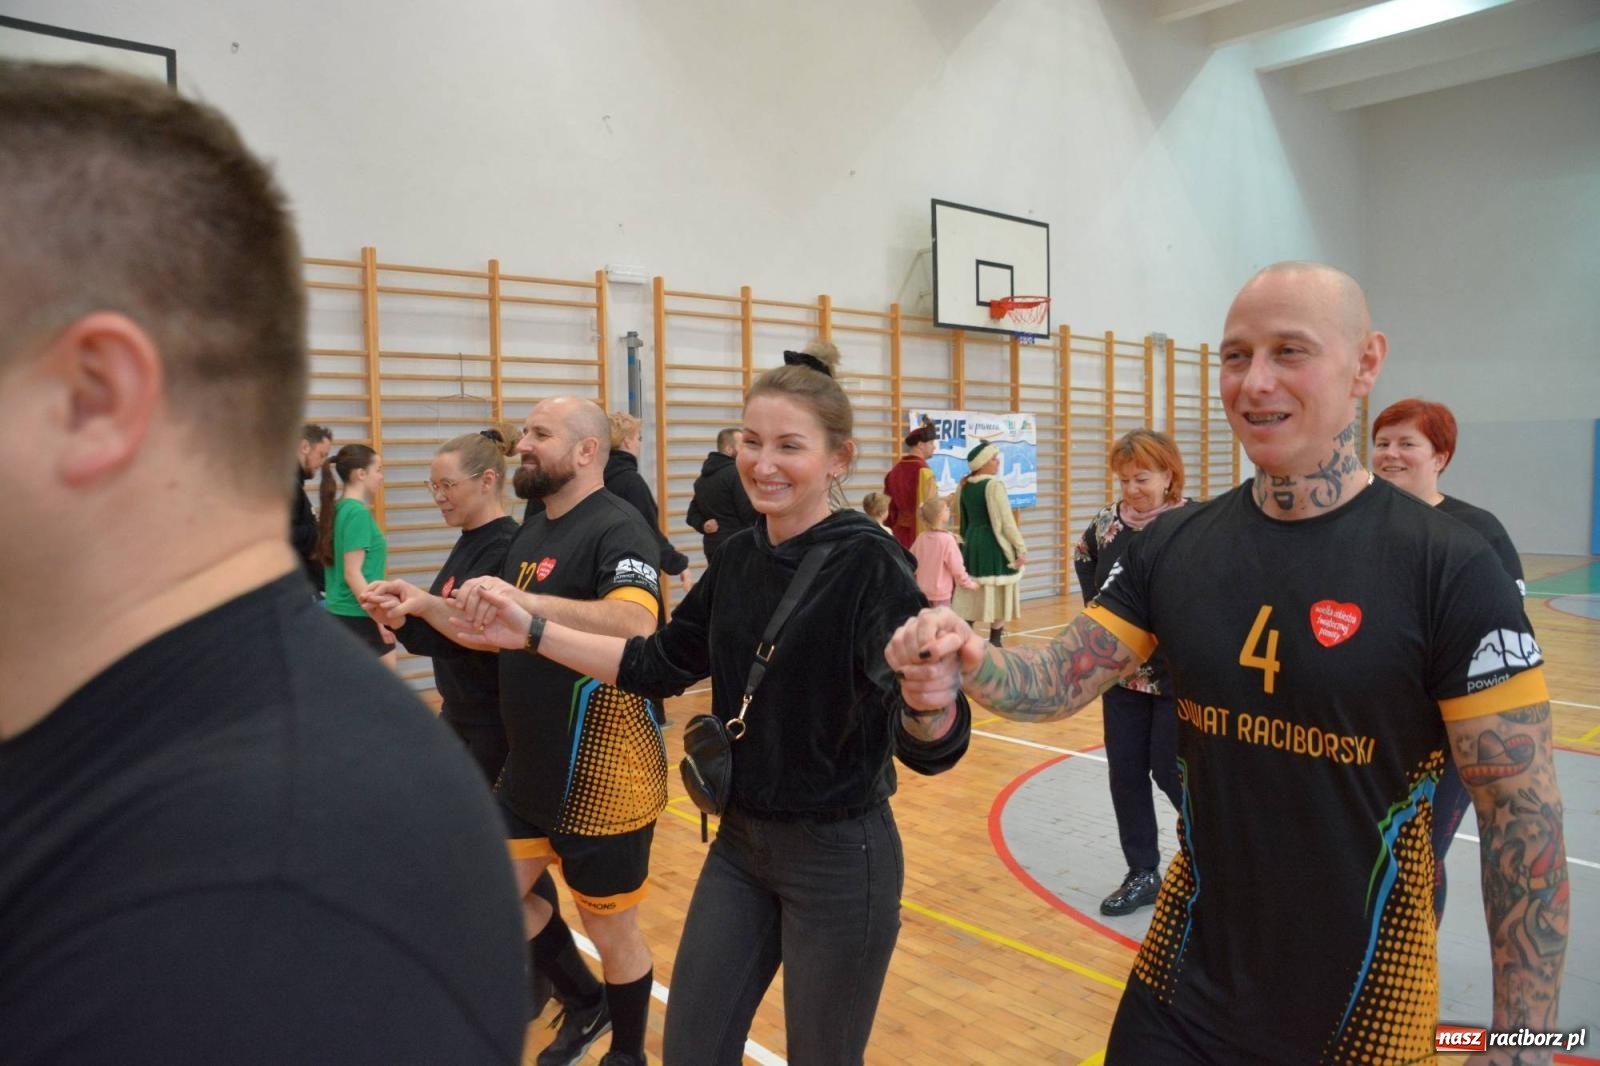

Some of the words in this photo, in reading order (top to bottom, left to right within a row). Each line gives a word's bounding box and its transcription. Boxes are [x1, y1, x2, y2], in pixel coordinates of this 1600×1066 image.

[918, 414, 967, 440] ERIE
[1239, 604, 1280, 694] 4
[1467, 673, 1511, 693] powiat
[1237, 713, 1376, 765] RACIBORSKI
